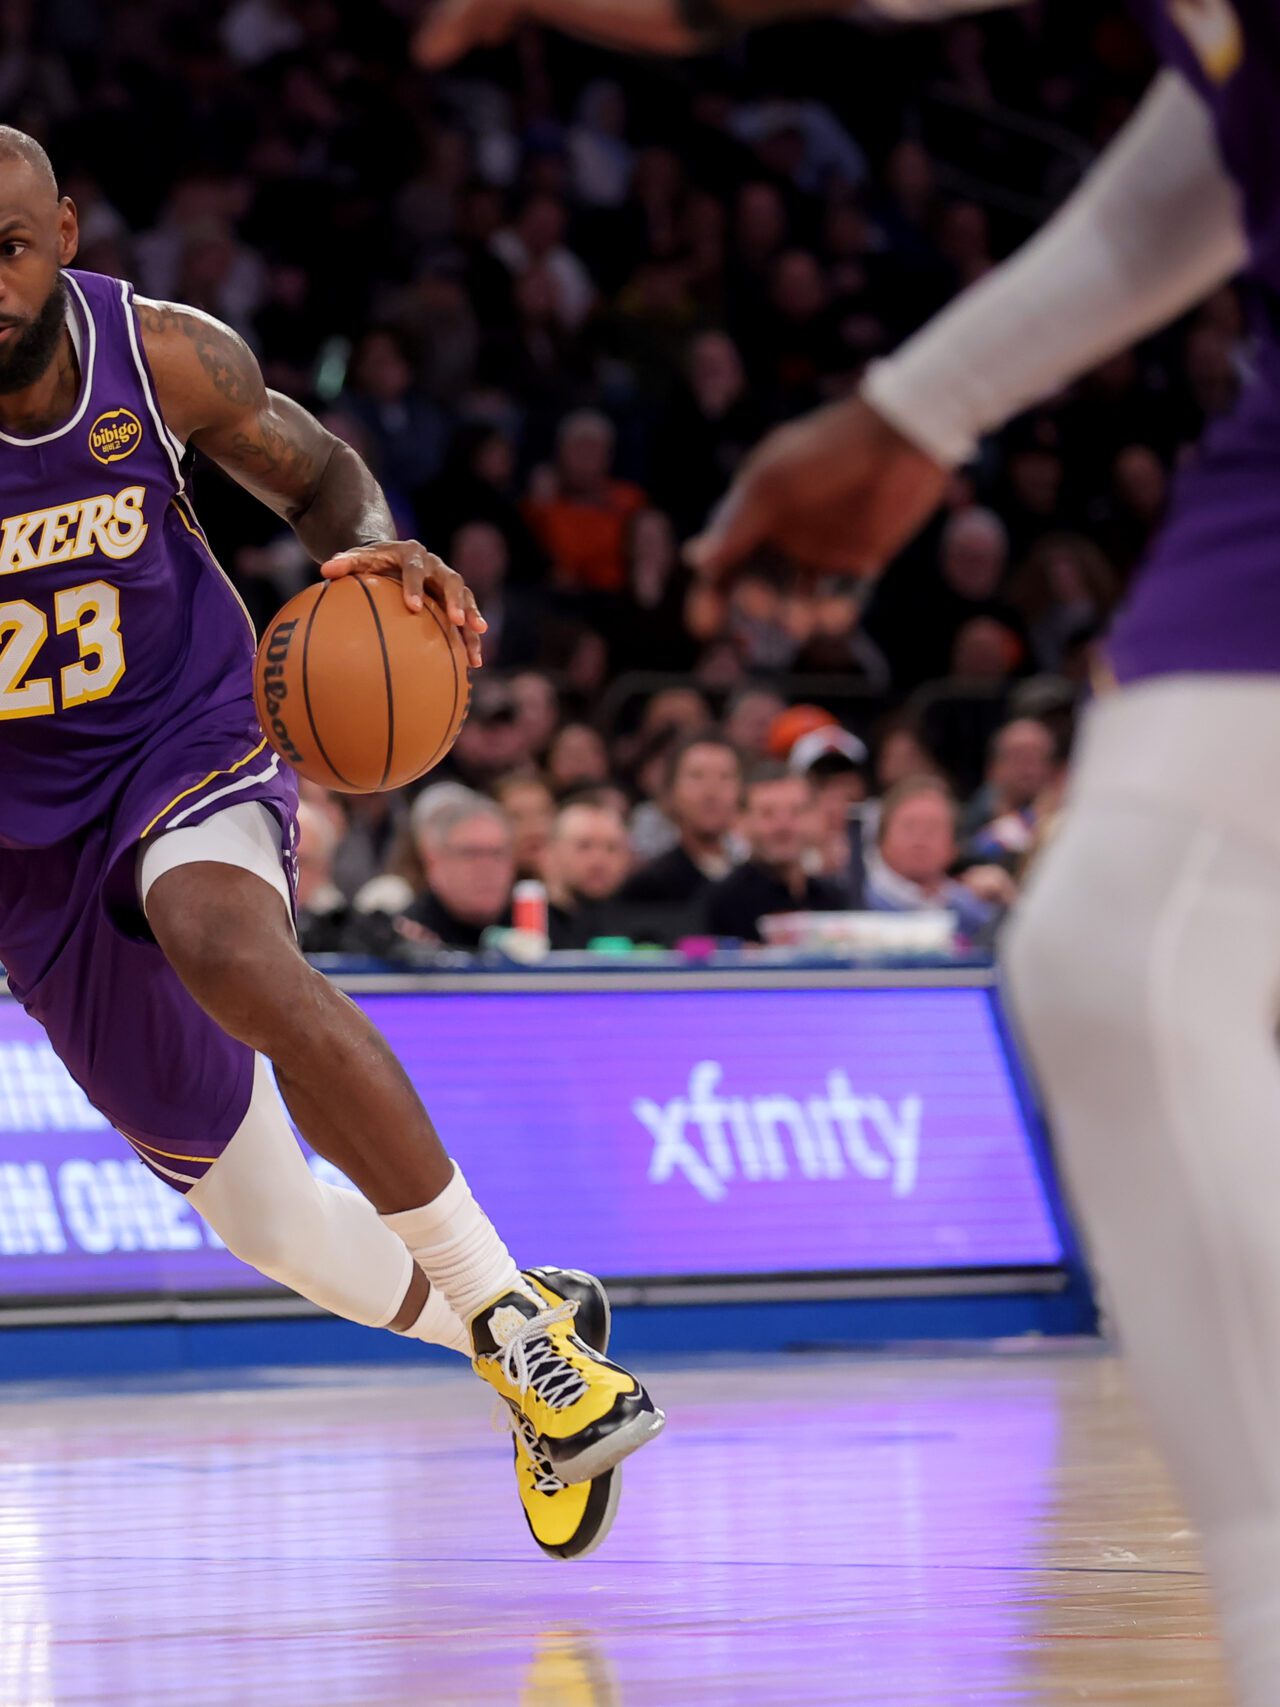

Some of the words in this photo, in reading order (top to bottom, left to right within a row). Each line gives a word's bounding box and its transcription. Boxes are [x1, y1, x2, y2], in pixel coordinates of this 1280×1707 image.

[92, 422, 138, 448] bibigo
[263, 617, 305, 763] Wilson
[632, 1059, 924, 1203] xfinity
